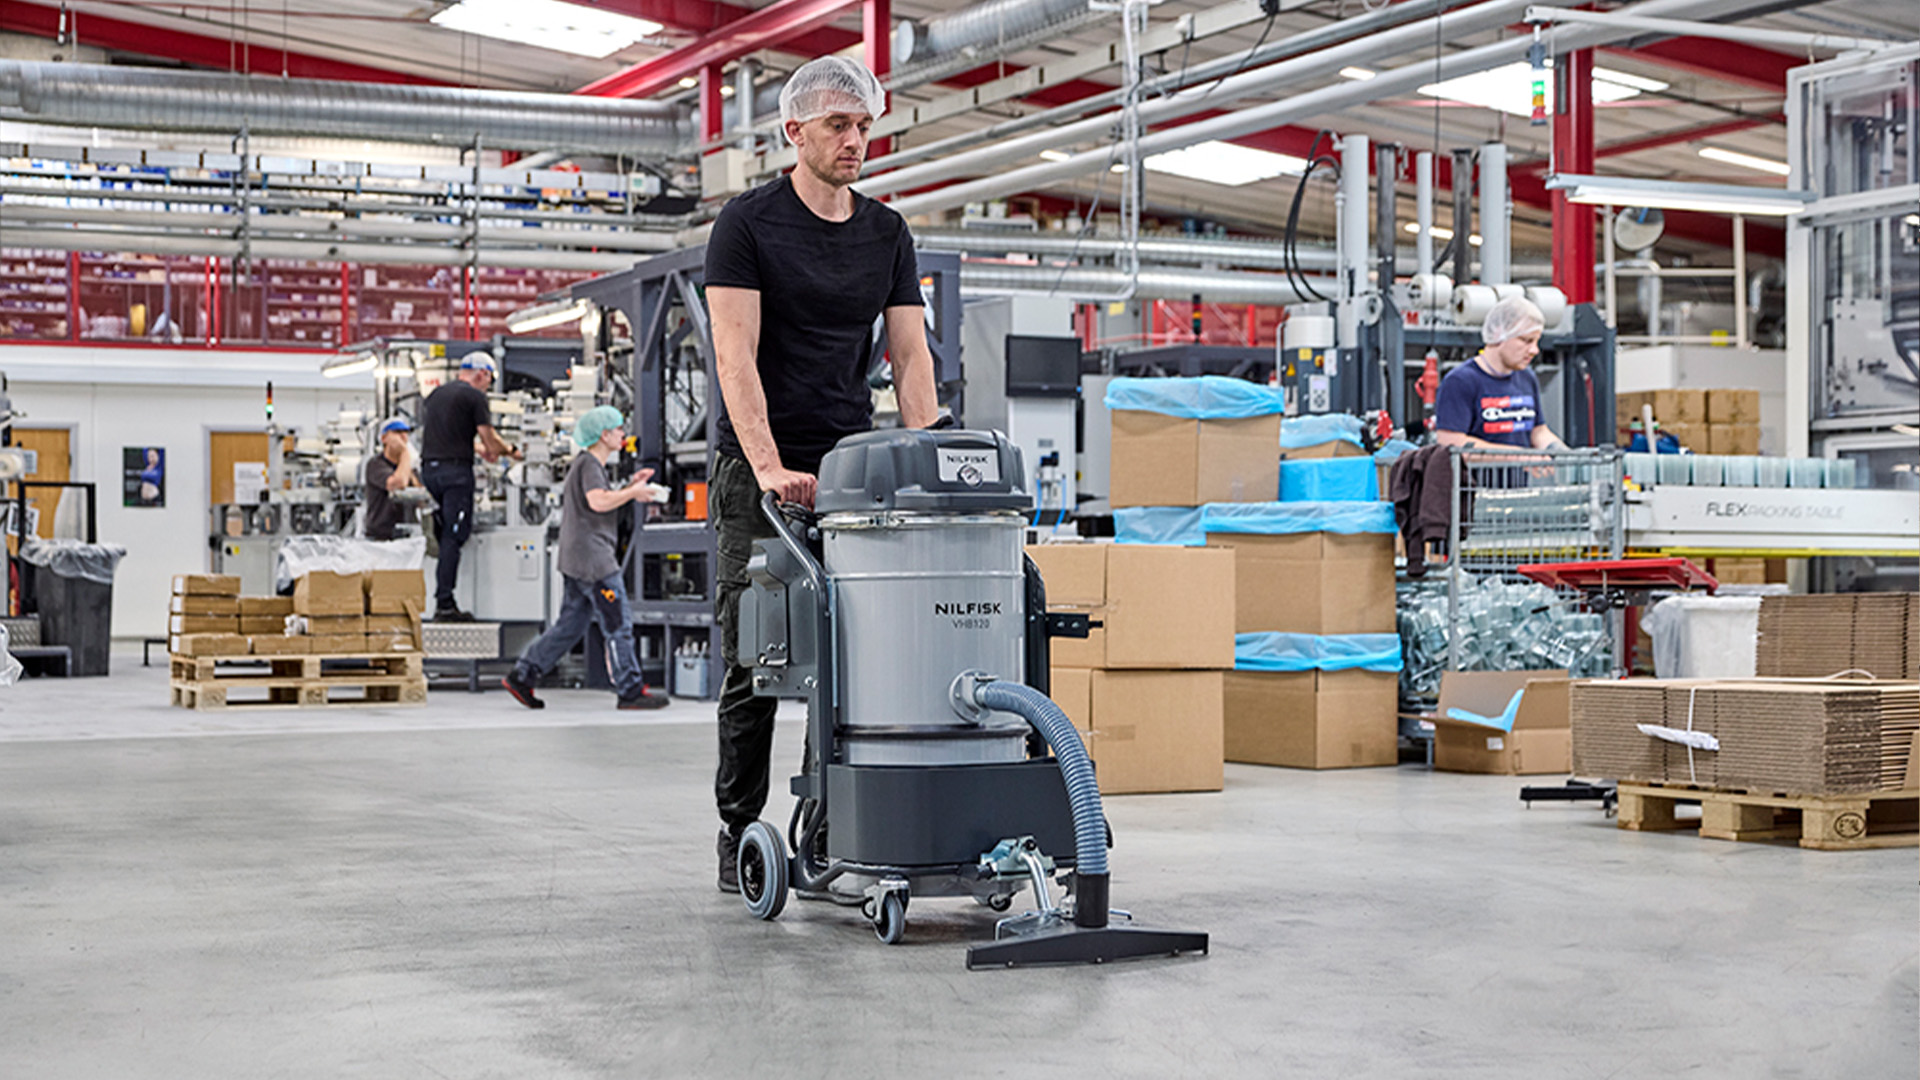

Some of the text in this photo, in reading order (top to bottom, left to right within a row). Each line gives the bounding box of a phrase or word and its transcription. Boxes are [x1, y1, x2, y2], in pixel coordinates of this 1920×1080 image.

[946, 455, 988, 464] NILFISK
[935, 602, 1002, 615] NILFISK
[952, 618, 990, 629] VHB120
